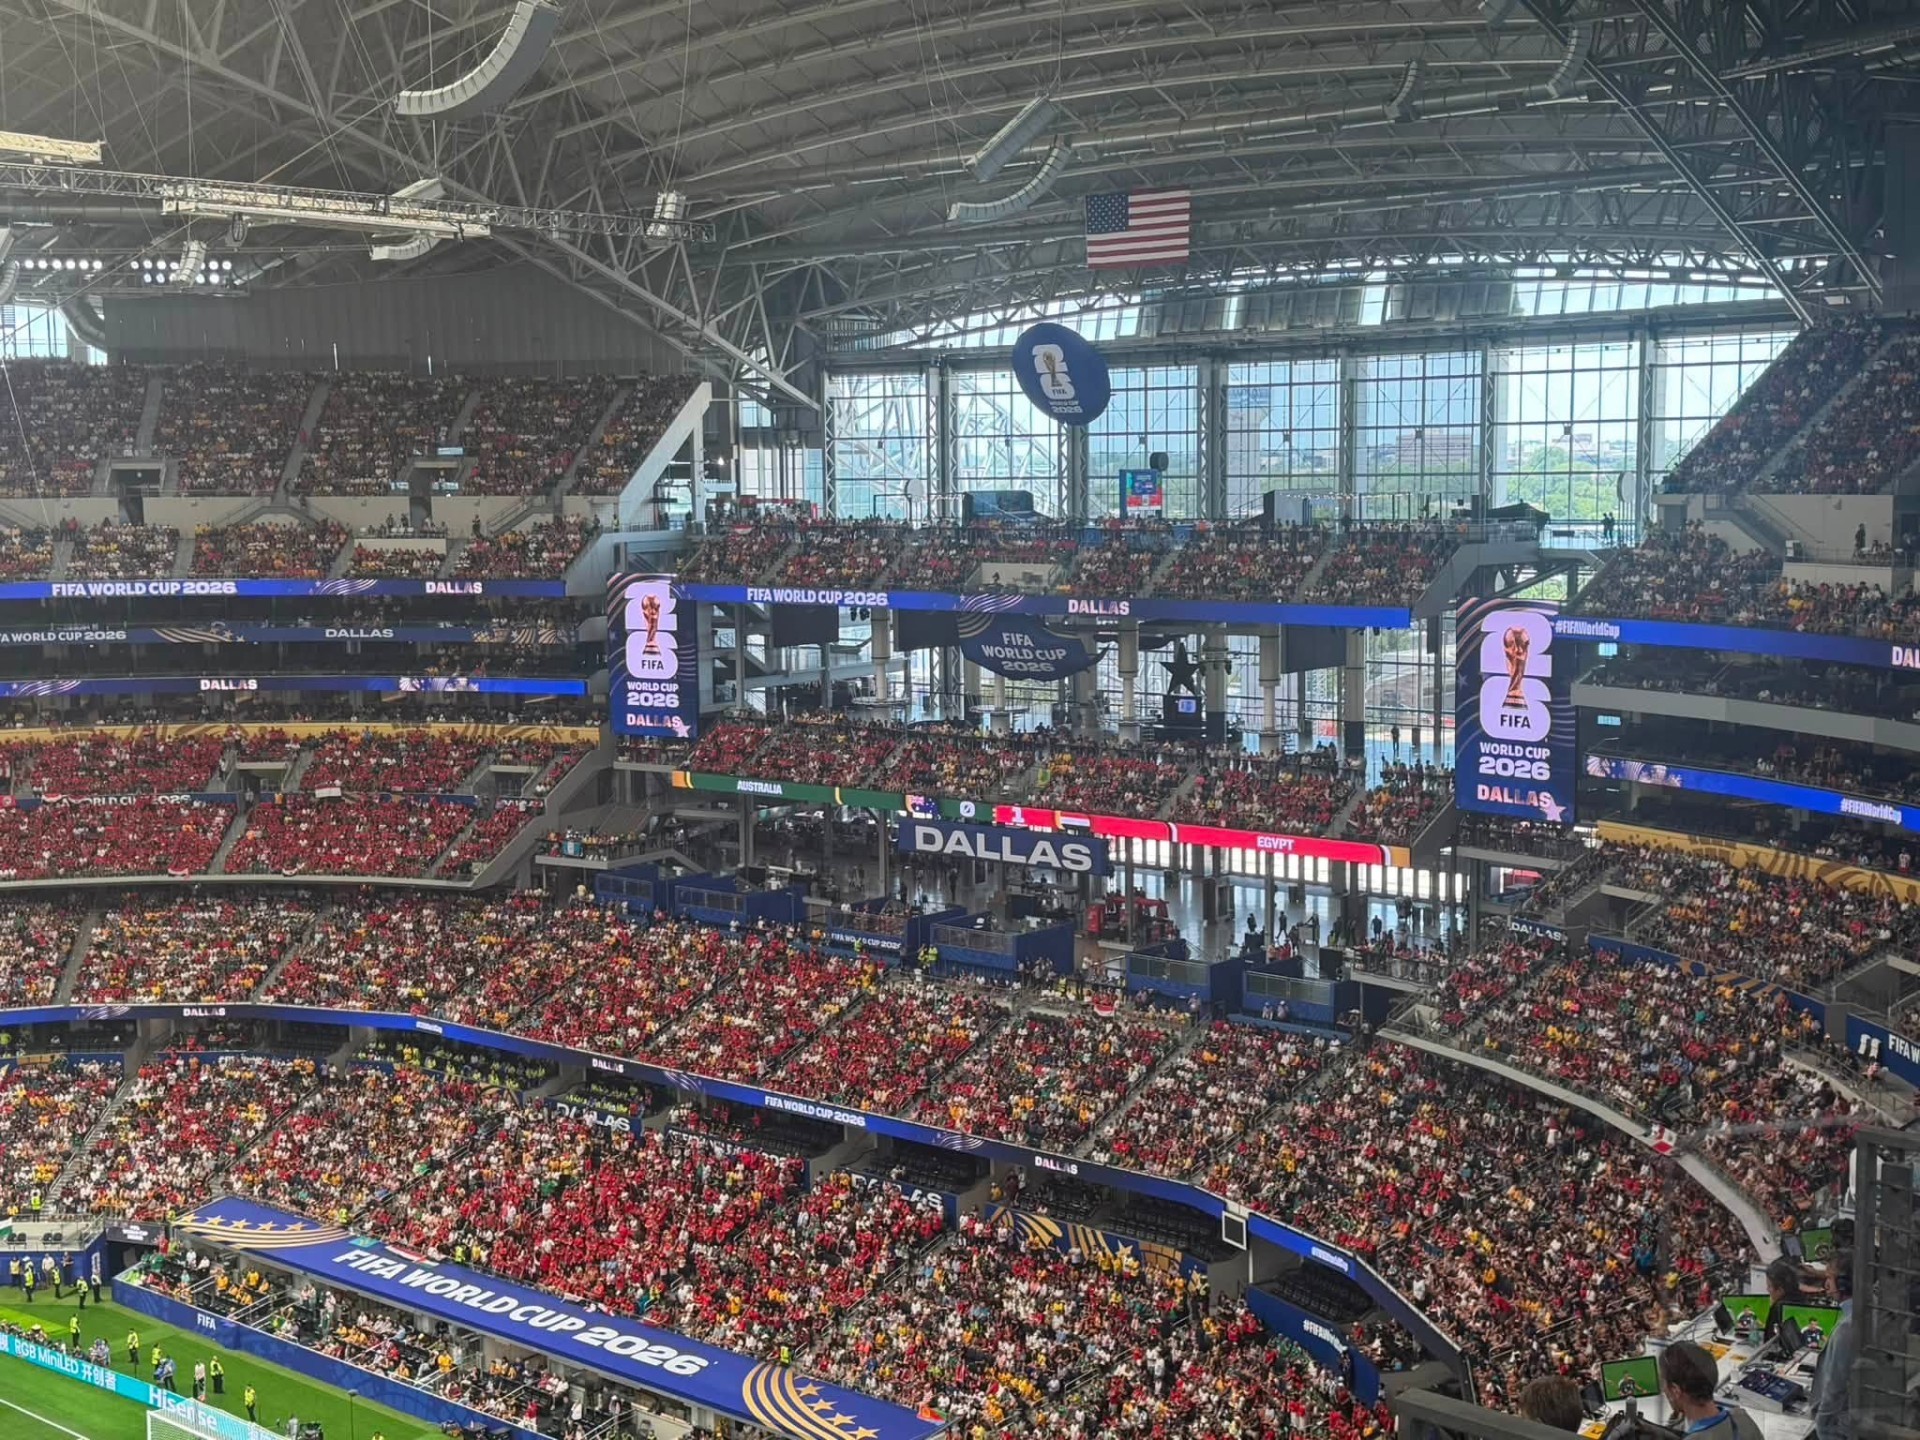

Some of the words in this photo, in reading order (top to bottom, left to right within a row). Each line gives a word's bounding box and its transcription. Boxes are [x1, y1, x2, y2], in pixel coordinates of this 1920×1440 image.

[52, 583, 87, 596] FIFA
[89, 582, 146, 596] WORLD
[149, 582, 181, 595] CUP
[183, 581, 237, 594] 2026
[425, 581, 482, 594] DALLAS
[747, 588, 772, 601] FIFA
[773, 588, 816, 603] WORLD
[818, 590, 843, 604] CUP
[844, 591, 888, 605] 2026
[1068, 599, 1130, 616] DALLAS
[10, 632, 57, 643] WORLD
[58, 631, 82, 642] CUP
[84, 630, 127, 641] 2026
[325, 628, 394, 638] DALLAS
[1555, 620, 1620, 639] #FIFAWorldCup
[1001, 632, 1034, 647] FIFA
[981, 644, 1034, 660] WORLD
[1035, 648, 1067, 661] CUP
[641, 659, 664, 670] FIFA
[1001, 661, 1056, 672] 2026
[200, 679, 258, 691] DALLAS
[627, 681, 659, 692] WORLD
[661, 682, 679, 693] CUP
[627, 692, 680, 708] 2026
[626, 713, 681, 728] DALLAS
[1500, 713, 1531, 730] FIFA
[1479, 742, 1523, 758] WORLD
[1525, 746, 1551, 760] CUP
[1478, 756, 1551, 781] 2026
[736, 779, 783, 796] AUSTRALIA
[1477, 784, 1552, 808] DALLAS
[959, 800, 976, 817] 0
[1011, 806, 1026, 823] 1
[1840, 798, 1902, 825] #FIFAWorldCup
[914, 825, 1093, 871] DALLAS
[1256, 835, 1295, 851] EGYPT
[868, 938, 880, 946] CUP
[183, 1007, 226, 1017] DALLAS
[1889, 1033, 1910, 1060] FIFA
[592, 1058, 625, 1074] DALLAS
[764, 1096, 783, 1108] FIFA
[784, 1100, 815, 1114] WORLD
[815, 1107, 833, 1119] CUP
[834, 1111, 866, 1126] 2026
[1034, 1156, 1078, 1175] DALLAS
[333, 1249, 405, 1280] FIFA
[400, 1270, 512, 1312] WORLD
[509, 1303, 586, 1333] CUP
[572, 1326, 708, 1377] 2026
[197, 1313, 216, 1331] FIFA
[14, 1338, 37, 1358] RGB
[38, 1347, 79, 1374] MiniLED
[82, 1363, 116, 1391] 开创者
[150, 1386, 218, 1430] Hisense
